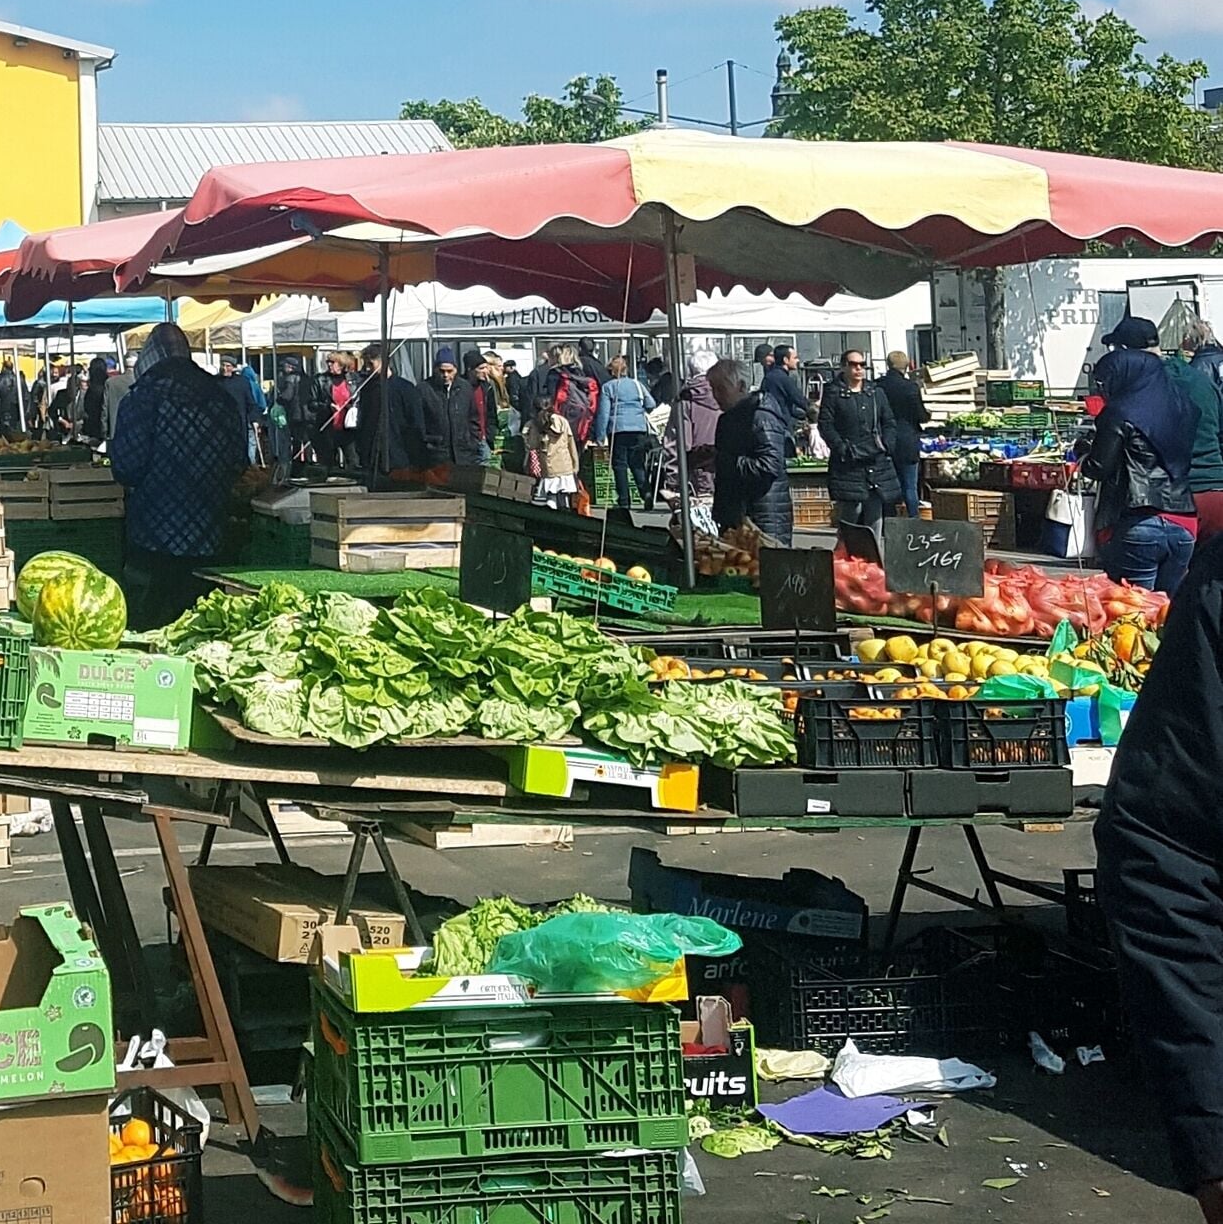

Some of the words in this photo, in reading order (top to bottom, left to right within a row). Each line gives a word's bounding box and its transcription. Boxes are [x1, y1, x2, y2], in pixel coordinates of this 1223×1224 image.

[78, 663, 136, 684] DULCE
[687, 896, 778, 929] Marlene
[0, 1070, 45, 1086] MELON
